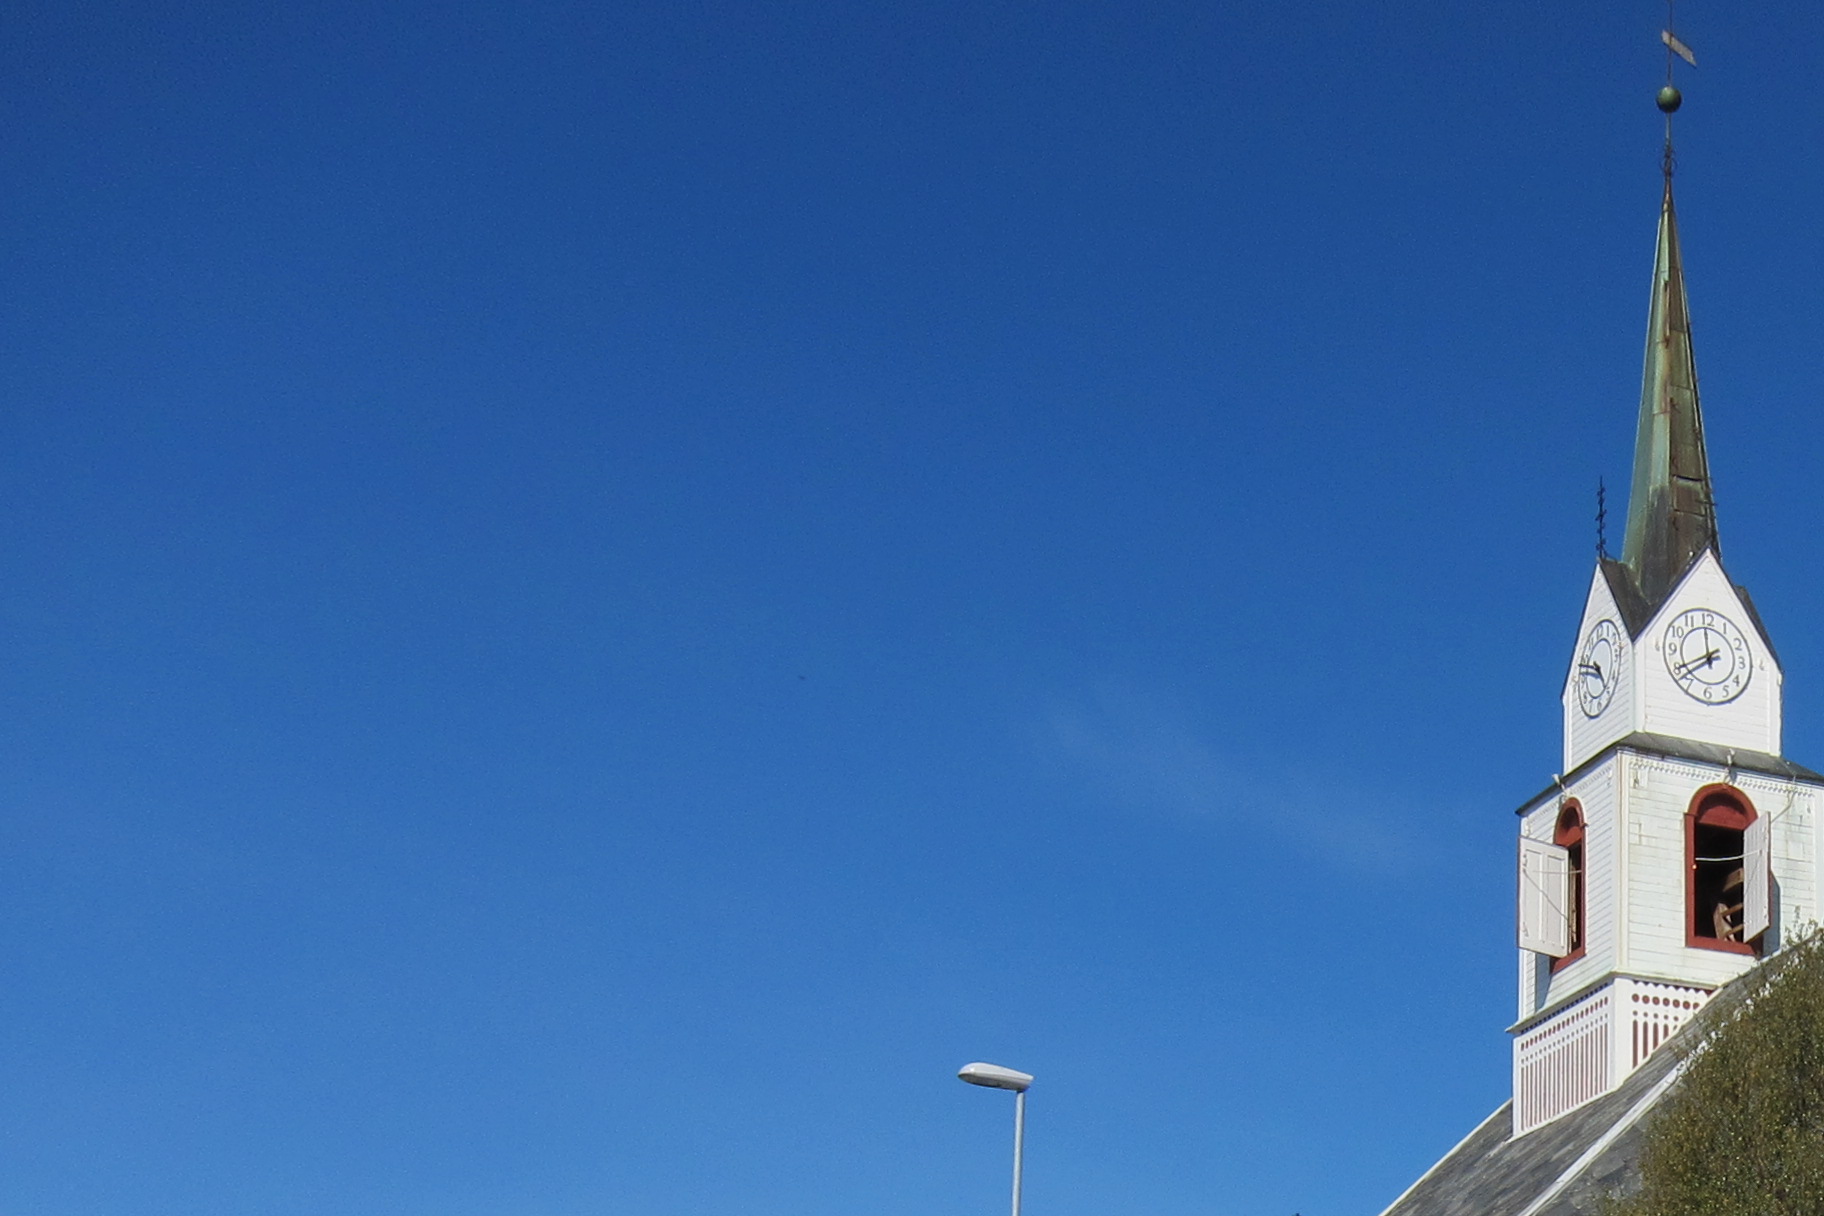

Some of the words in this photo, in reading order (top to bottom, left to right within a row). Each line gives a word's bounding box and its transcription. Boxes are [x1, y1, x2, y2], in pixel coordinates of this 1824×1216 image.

[1685, 614, 1694, 628] 11
[1702, 613, 1715, 627] 12
[1671, 625, 1684, 638] 10
[1723, 622, 1727, 635] 1
[1668, 642, 1677, 656] 9
[1733, 637, 1743, 651] 2
[1673, 662, 1681, 675] 8
[1738, 656, 1746, 670] 3
[1683, 676, 1694, 693] 7
[1732, 674, 1740, 687] 4
[1703, 687, 1712, 700] 6
[1722, 685, 1730, 698] 5
